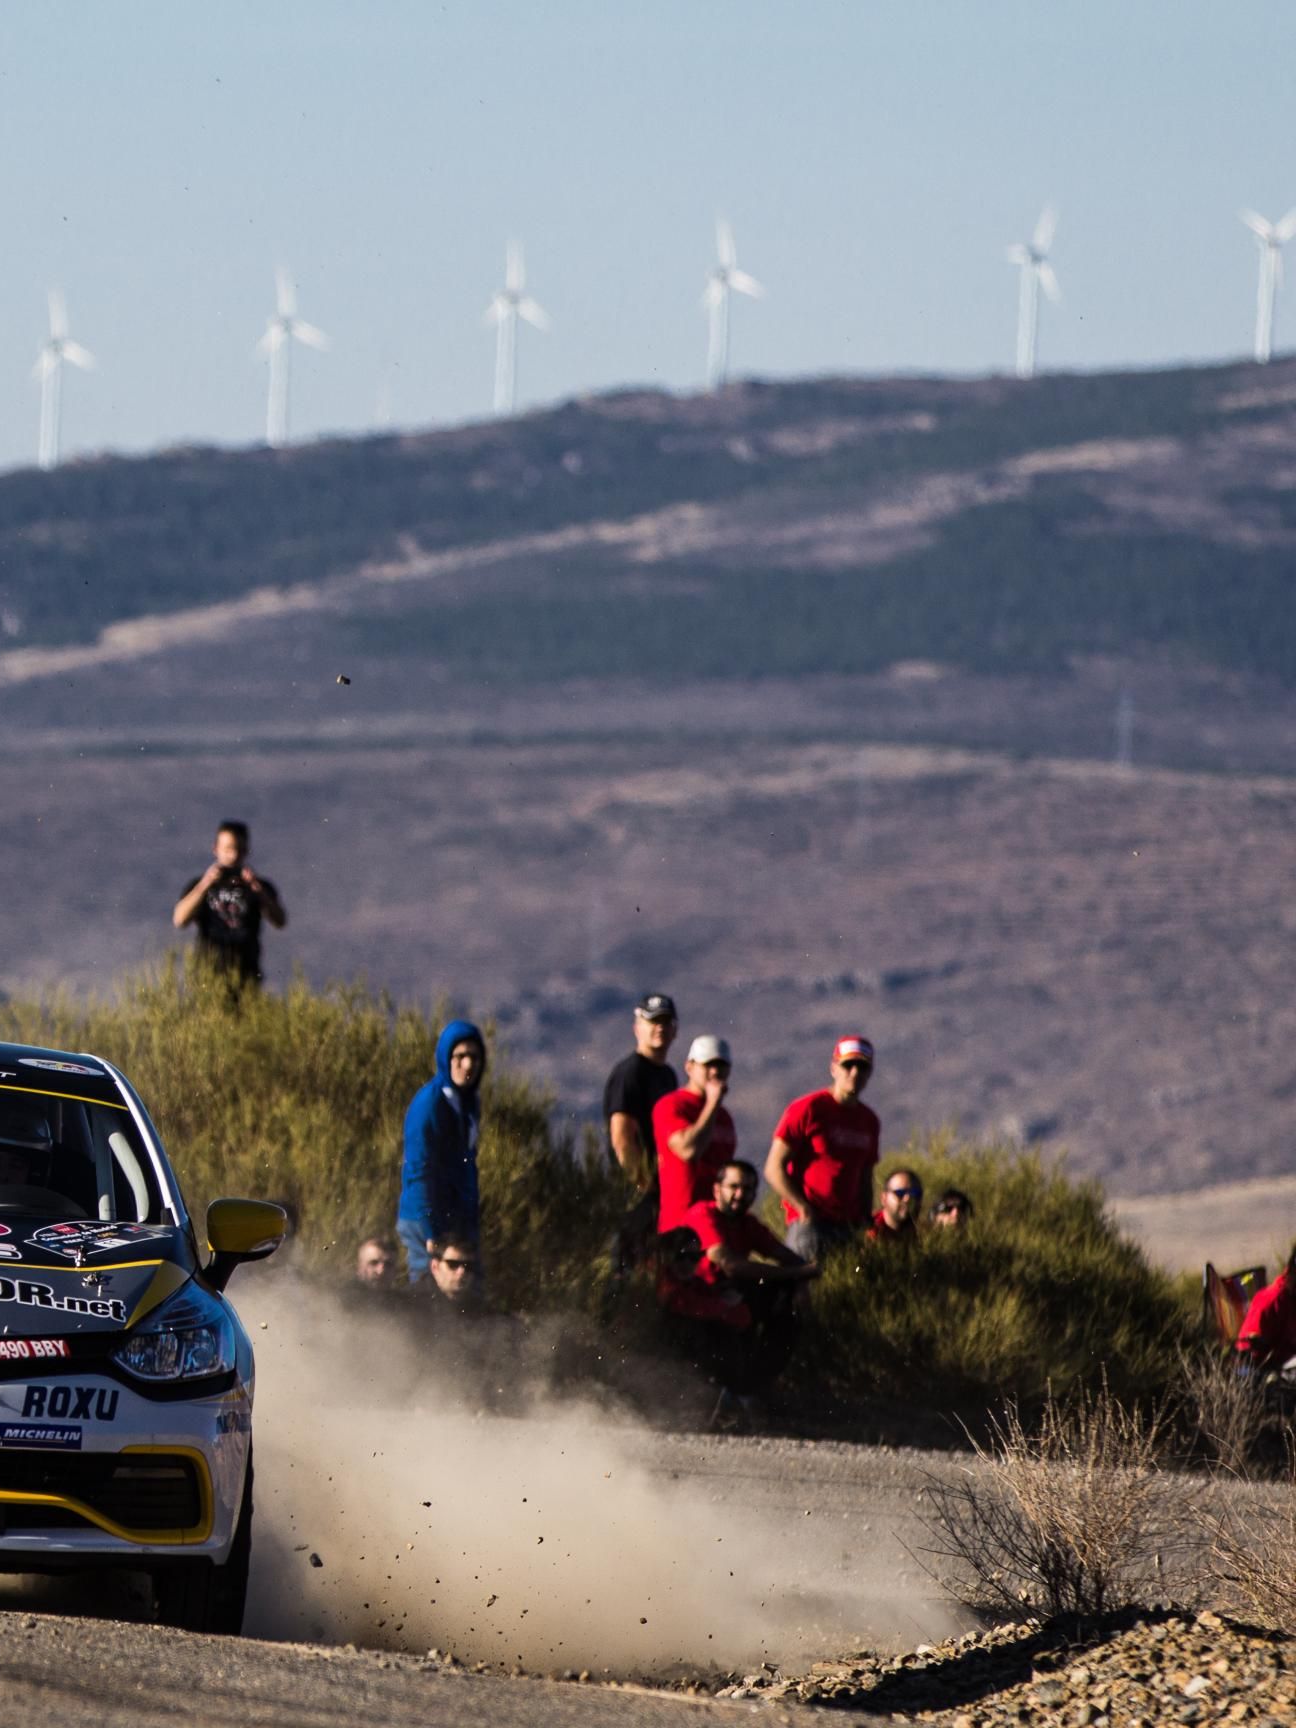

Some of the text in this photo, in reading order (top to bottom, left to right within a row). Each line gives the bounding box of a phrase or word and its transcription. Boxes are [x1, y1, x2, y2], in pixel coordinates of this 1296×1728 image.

[30, 1339, 67, 1358] BBY
[21, 1385, 119, 1421] ROXU
[4, 1428, 81, 1441] MICHELIN
